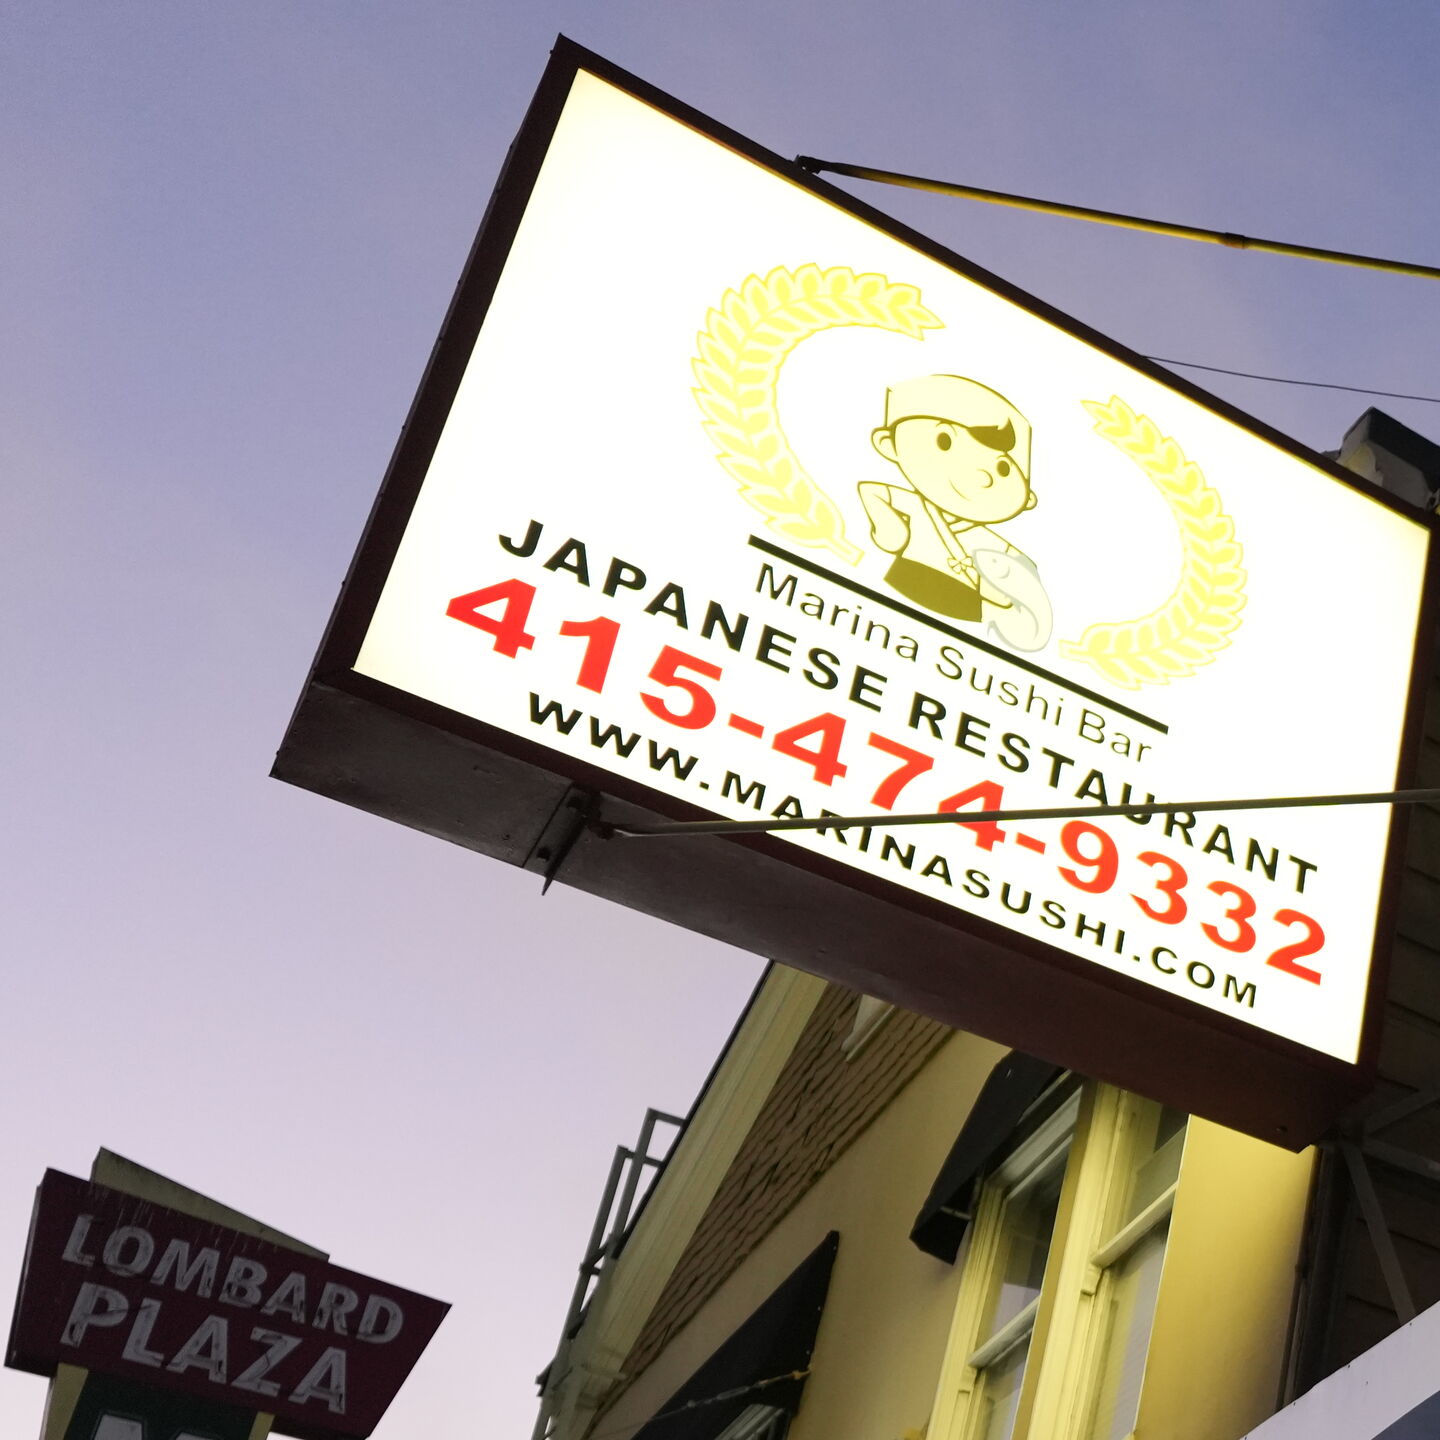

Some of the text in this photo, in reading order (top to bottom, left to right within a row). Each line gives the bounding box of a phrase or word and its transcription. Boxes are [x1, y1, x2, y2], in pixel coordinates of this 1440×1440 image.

[445, 578, 1326, 986] 415-474-9332
[498, 519, 1318, 894] JAPANESE RESTAURANT
[755, 562, 1153, 763] Marina Sushi Bar
[528, 691, 1258, 1009] WWW.MARINASUSHI.COM
[59, 1283, 349, 1417] PLAZA
[61, 1212, 406, 1346] LOMBARD
